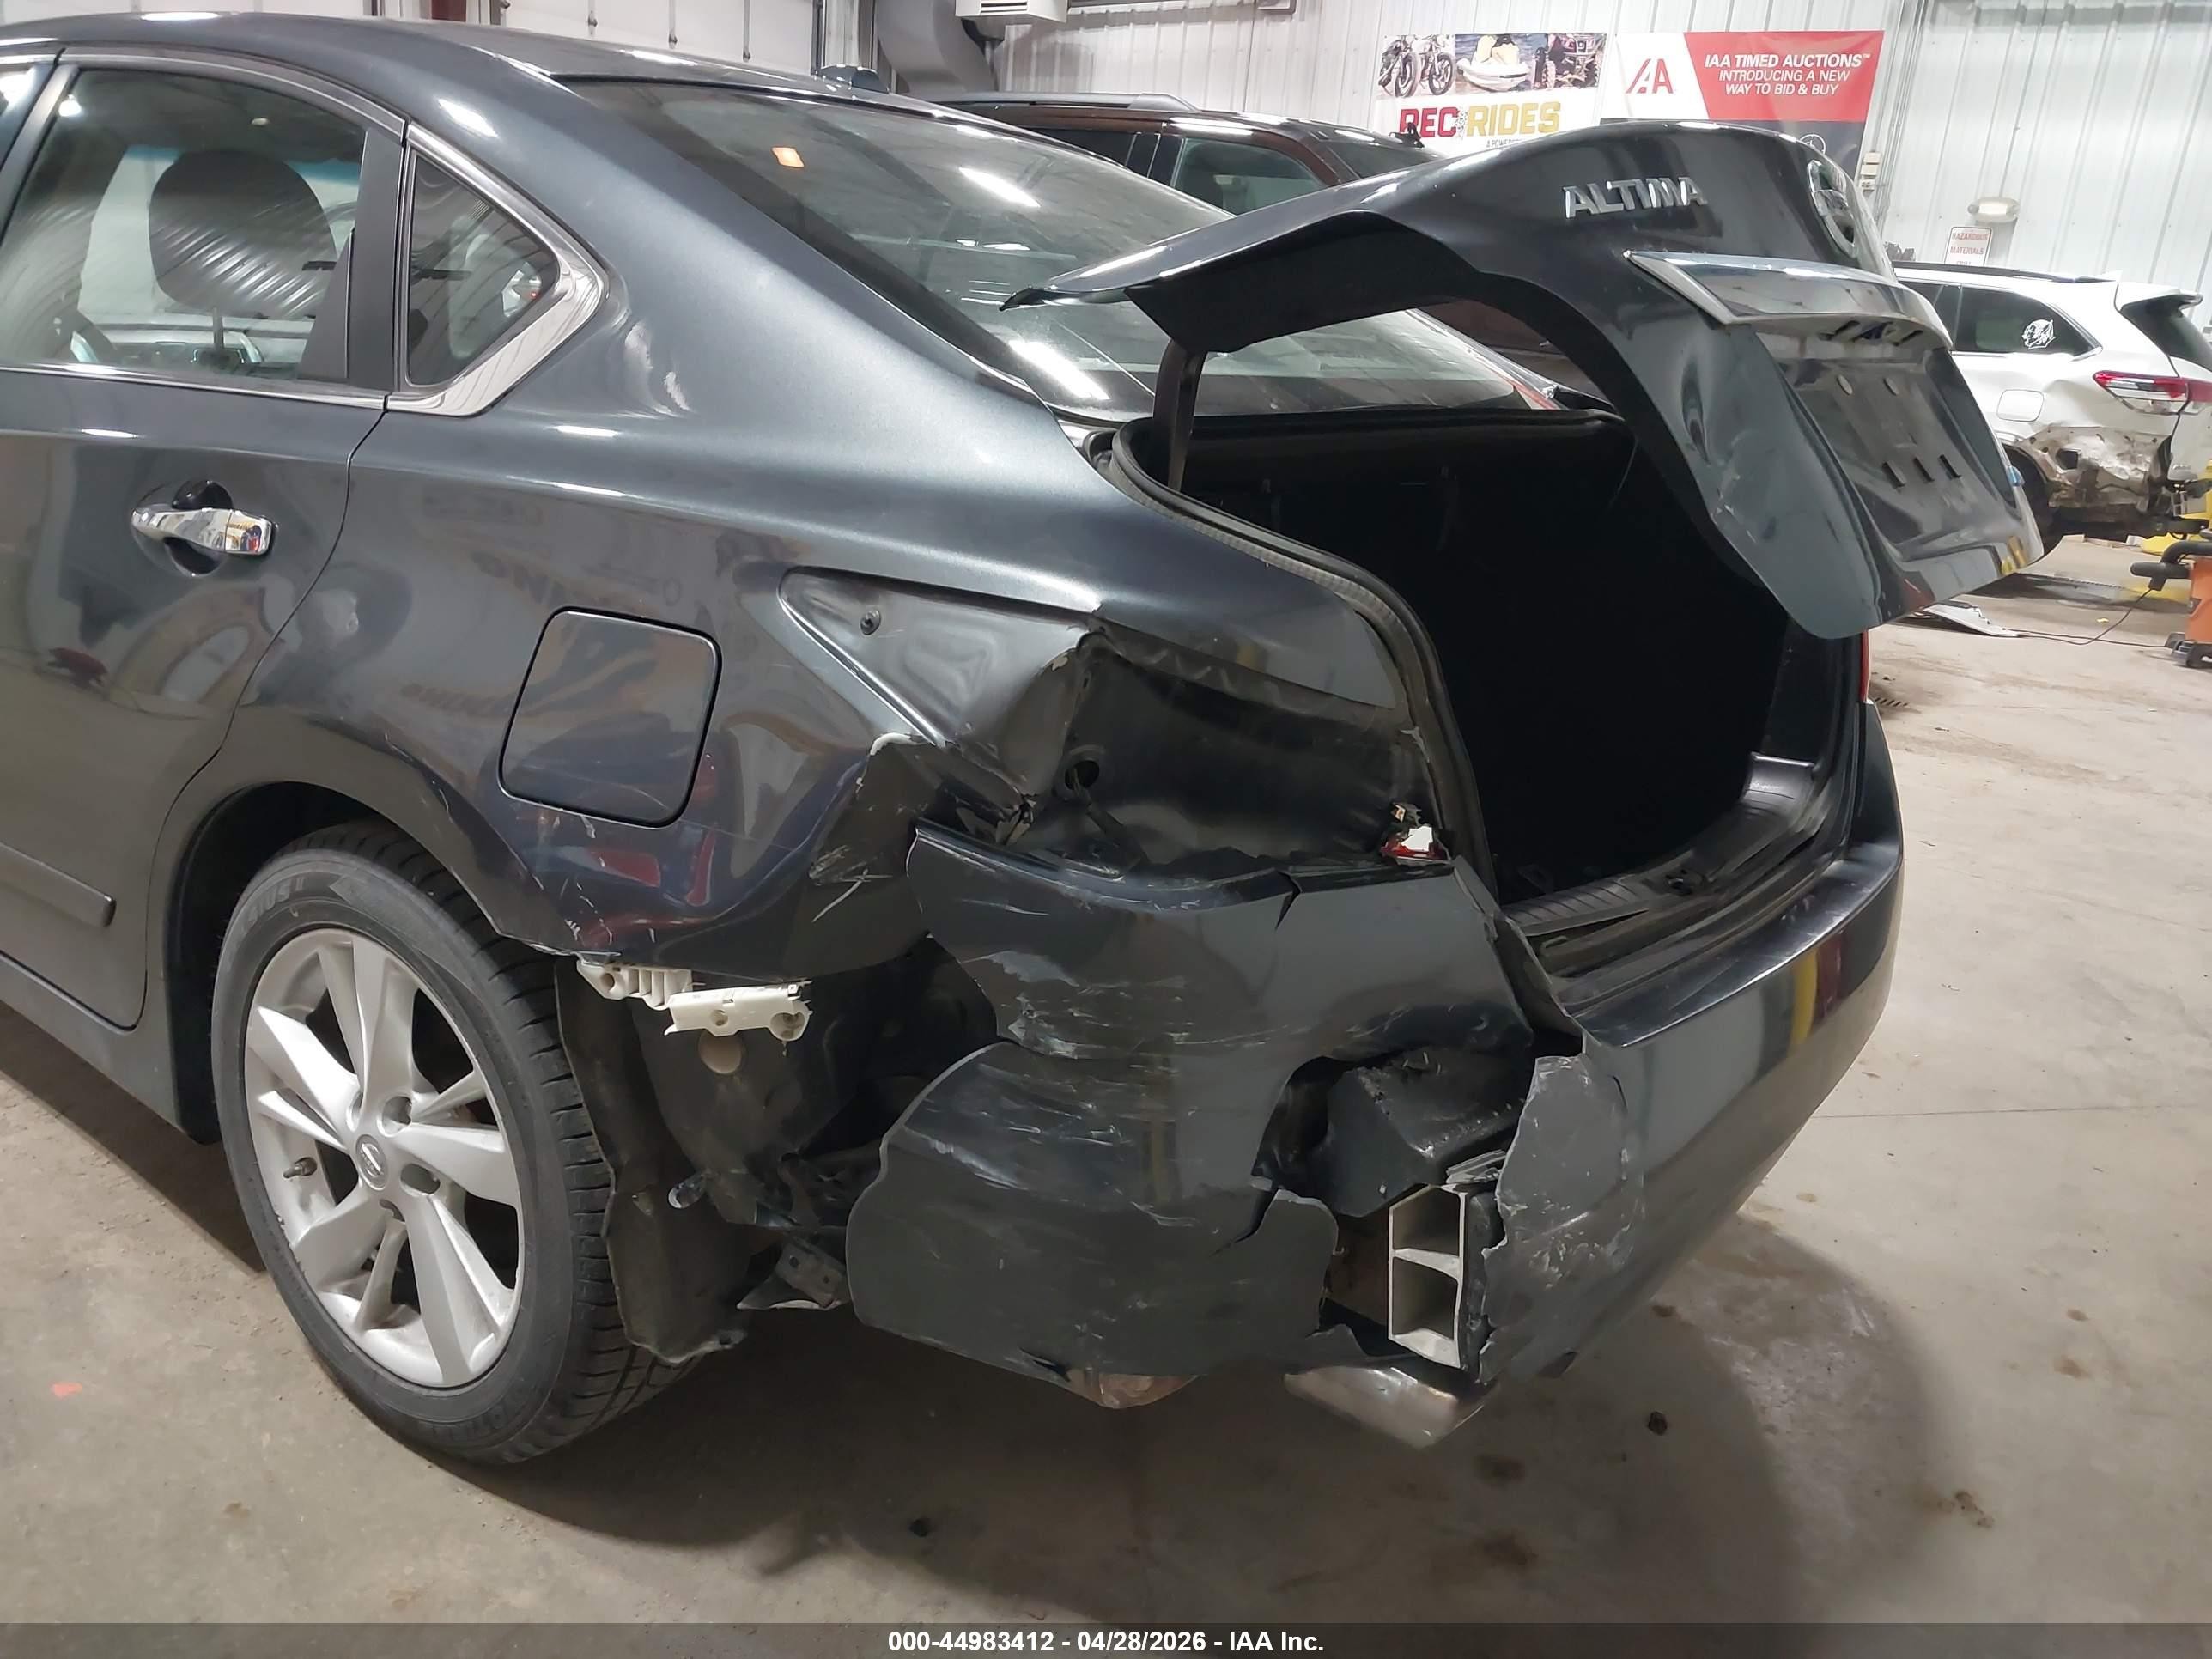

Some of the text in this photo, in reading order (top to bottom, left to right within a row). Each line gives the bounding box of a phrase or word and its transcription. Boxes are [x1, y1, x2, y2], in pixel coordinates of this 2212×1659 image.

[1705, 54, 1731, 68] IAA
[1735, 54, 1778, 68] TIMED
[1719, 70, 1850, 82] INTRODUCING A NEW
[1725, 83, 1839, 95] WAY TO BID & BUY
[1399, 101, 1561, 137] REC RIDES
[1562, 177, 1709, 219] ALTIMA
[1950, 246, 1984, 255] MATERIALS
